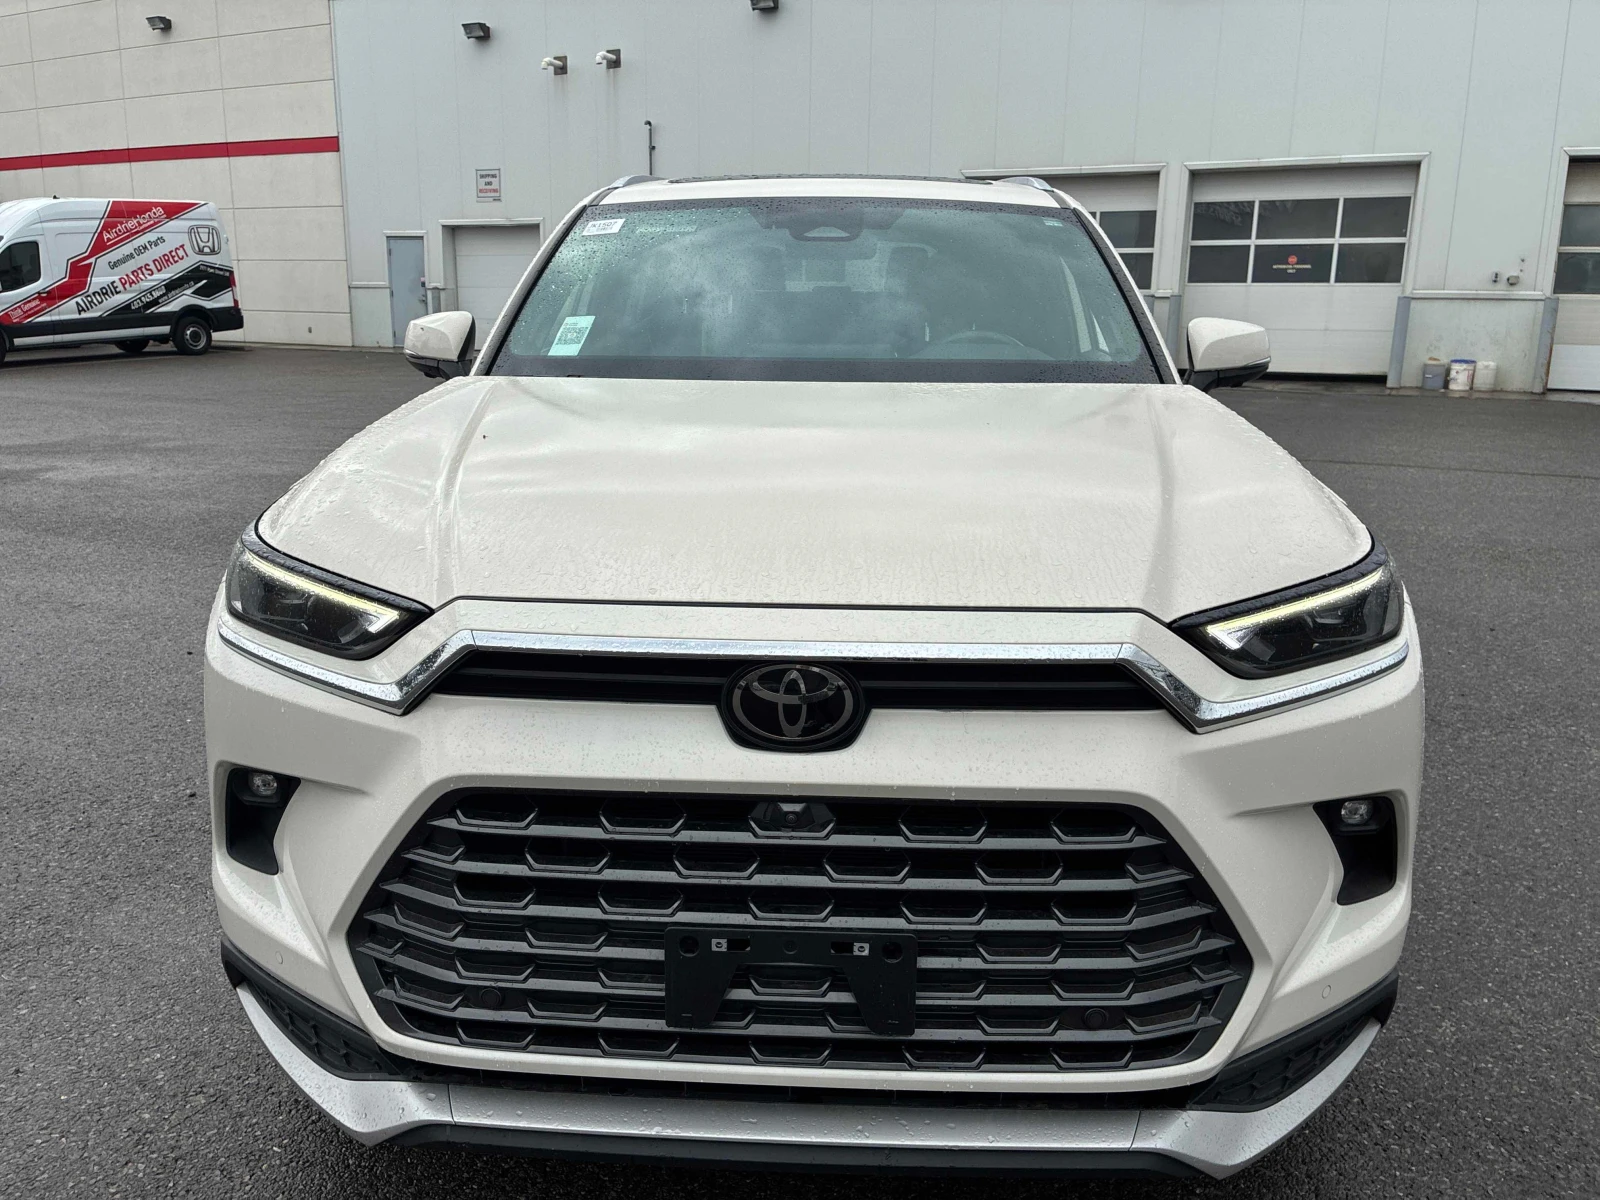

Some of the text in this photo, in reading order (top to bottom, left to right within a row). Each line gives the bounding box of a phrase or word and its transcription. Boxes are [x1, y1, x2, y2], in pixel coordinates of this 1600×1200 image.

[102, 206, 165, 243] AirdrieHonda
[108, 236, 166, 270] Genuine OEM Parts
[75, 280, 122, 315] AIRDRIE
[118, 263, 154, 291] PARTS
[152, 244, 189, 273] DIRECT
